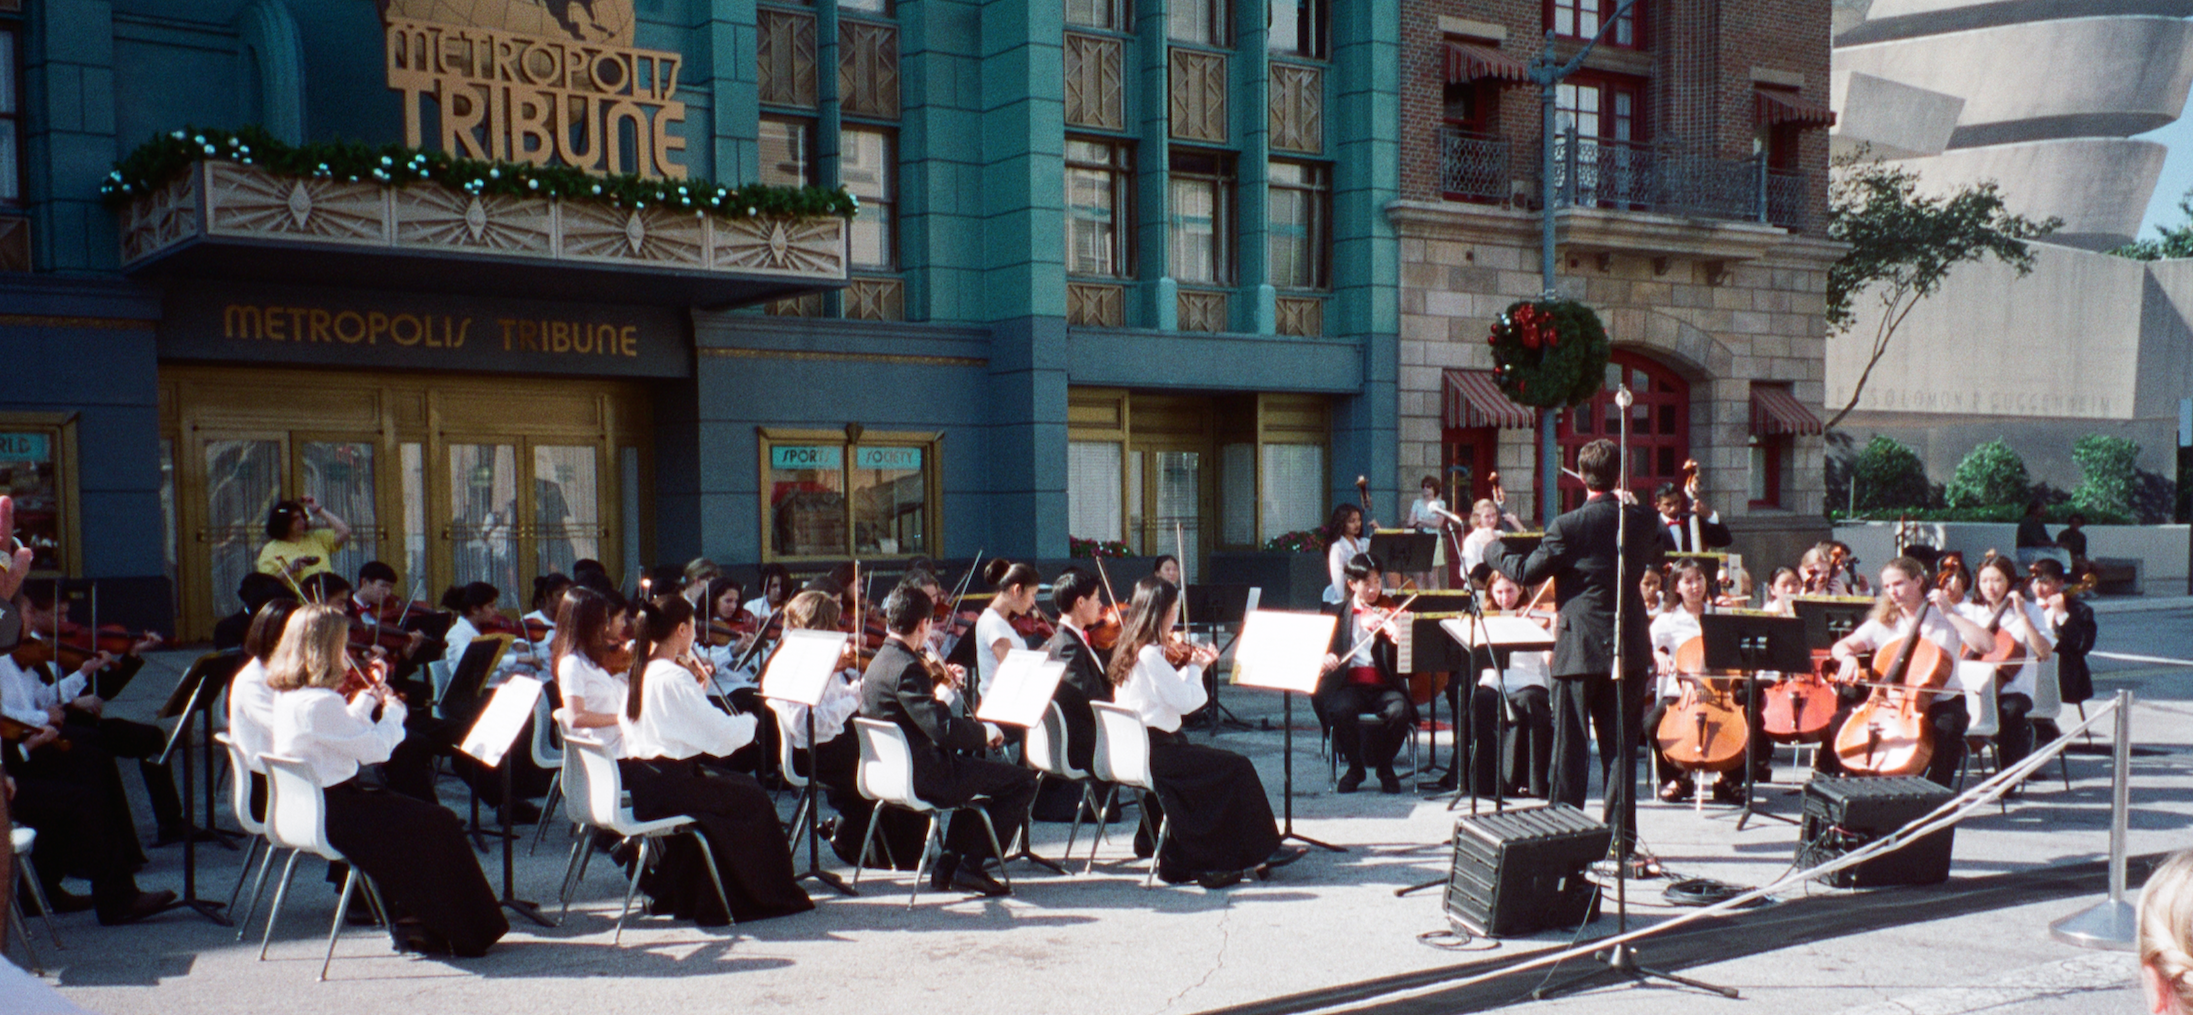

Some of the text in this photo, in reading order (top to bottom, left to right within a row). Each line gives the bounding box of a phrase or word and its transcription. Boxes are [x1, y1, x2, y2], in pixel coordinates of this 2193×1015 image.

[389, 24, 681, 99] METROPOLIS
[389, 78, 685, 180] TRIBUNE
[225, 306, 637, 356] METROPOLIS TRIBUNE
[782, 449, 830, 463] SPORTS
[866, 450, 912, 463] SOCIETY
